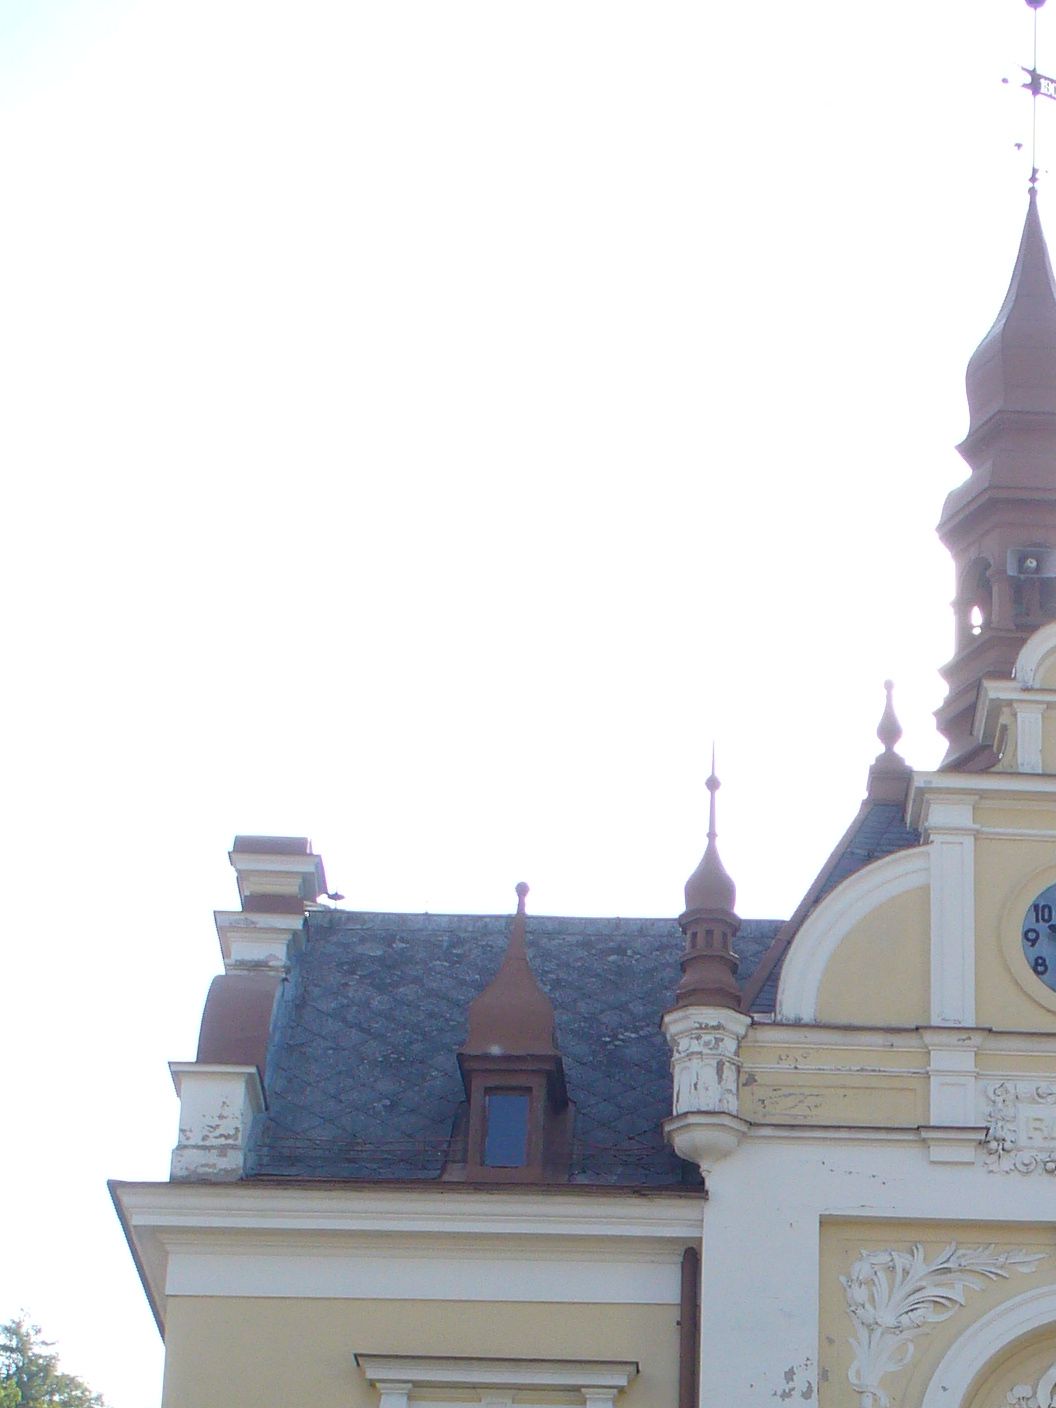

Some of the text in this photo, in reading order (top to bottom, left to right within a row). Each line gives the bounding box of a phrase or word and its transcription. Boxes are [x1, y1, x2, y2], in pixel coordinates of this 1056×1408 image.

[1033, 904, 1053, 923] 10
[1024, 928, 1040, 948] 9
[1032, 956, 1049, 976] 8
